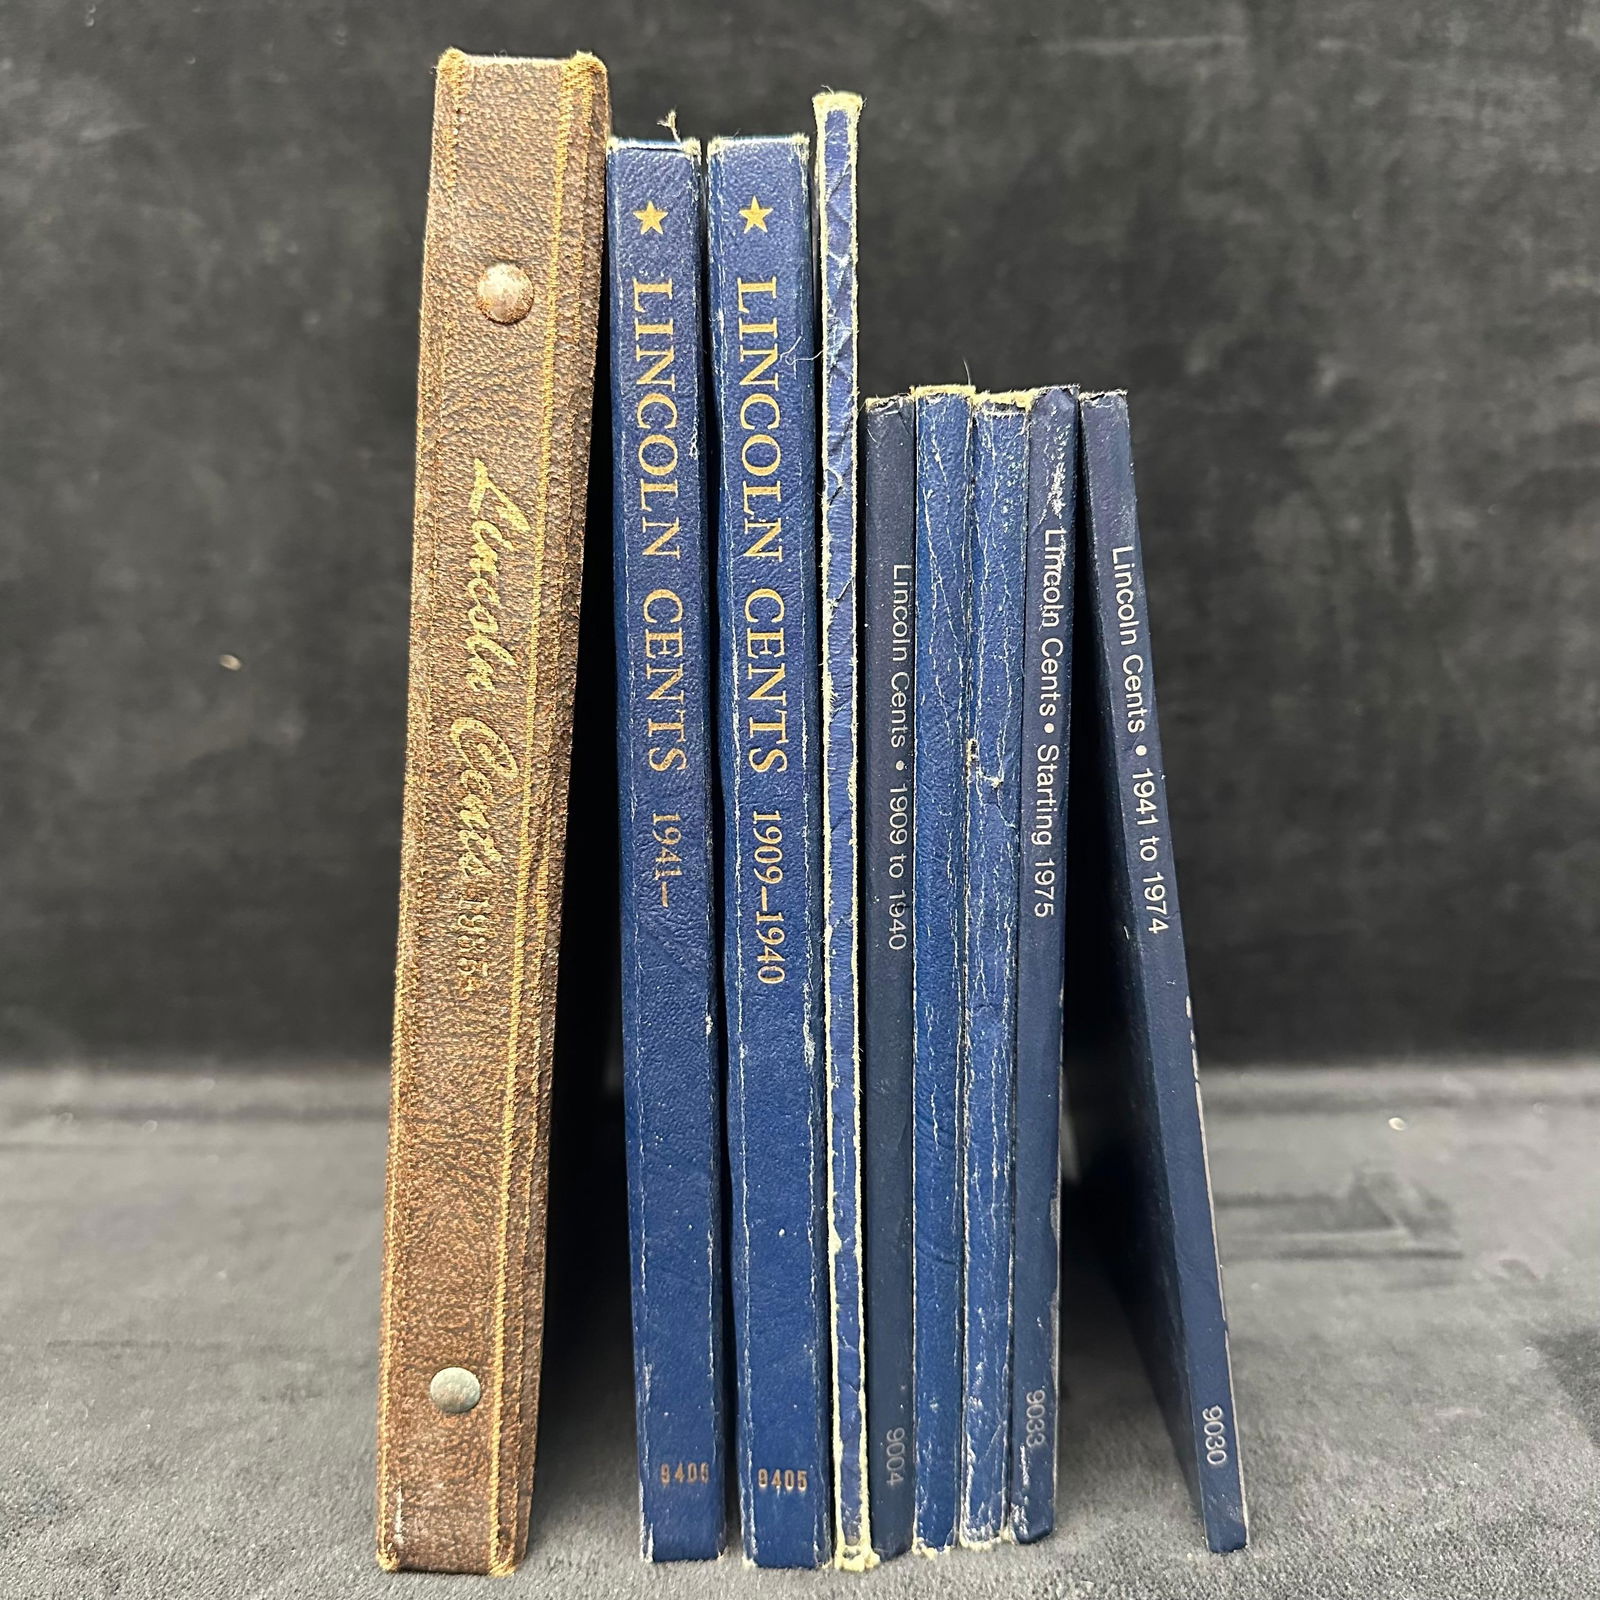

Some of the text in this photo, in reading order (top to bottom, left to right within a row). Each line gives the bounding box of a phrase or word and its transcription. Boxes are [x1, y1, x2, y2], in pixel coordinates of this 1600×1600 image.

[632, 278, 681, 558] LINCOLN
[736, 276, 784, 560] LINCOLN
[465, 459, 530, 692] Lincoln
[642, 588, 687, 773] CENTS
[744, 588, 788, 774] CENTS
[889, 564, 912, 949] Lincoln Cents 1909 to 1940
[1032, 529, 1064, 918] Lincoln Cents Starting 1975
[1112, 545, 1169, 934] Lincoln Cents 1941 to 1974
[449, 717, 519, 881] Cents
[757, 1468, 808, 1493] 9405
[886, 1427, 906, 1487] 9004
[1027, 1388, 1047, 1448] 9033
[1202, 1404, 1228, 1467] 9030
